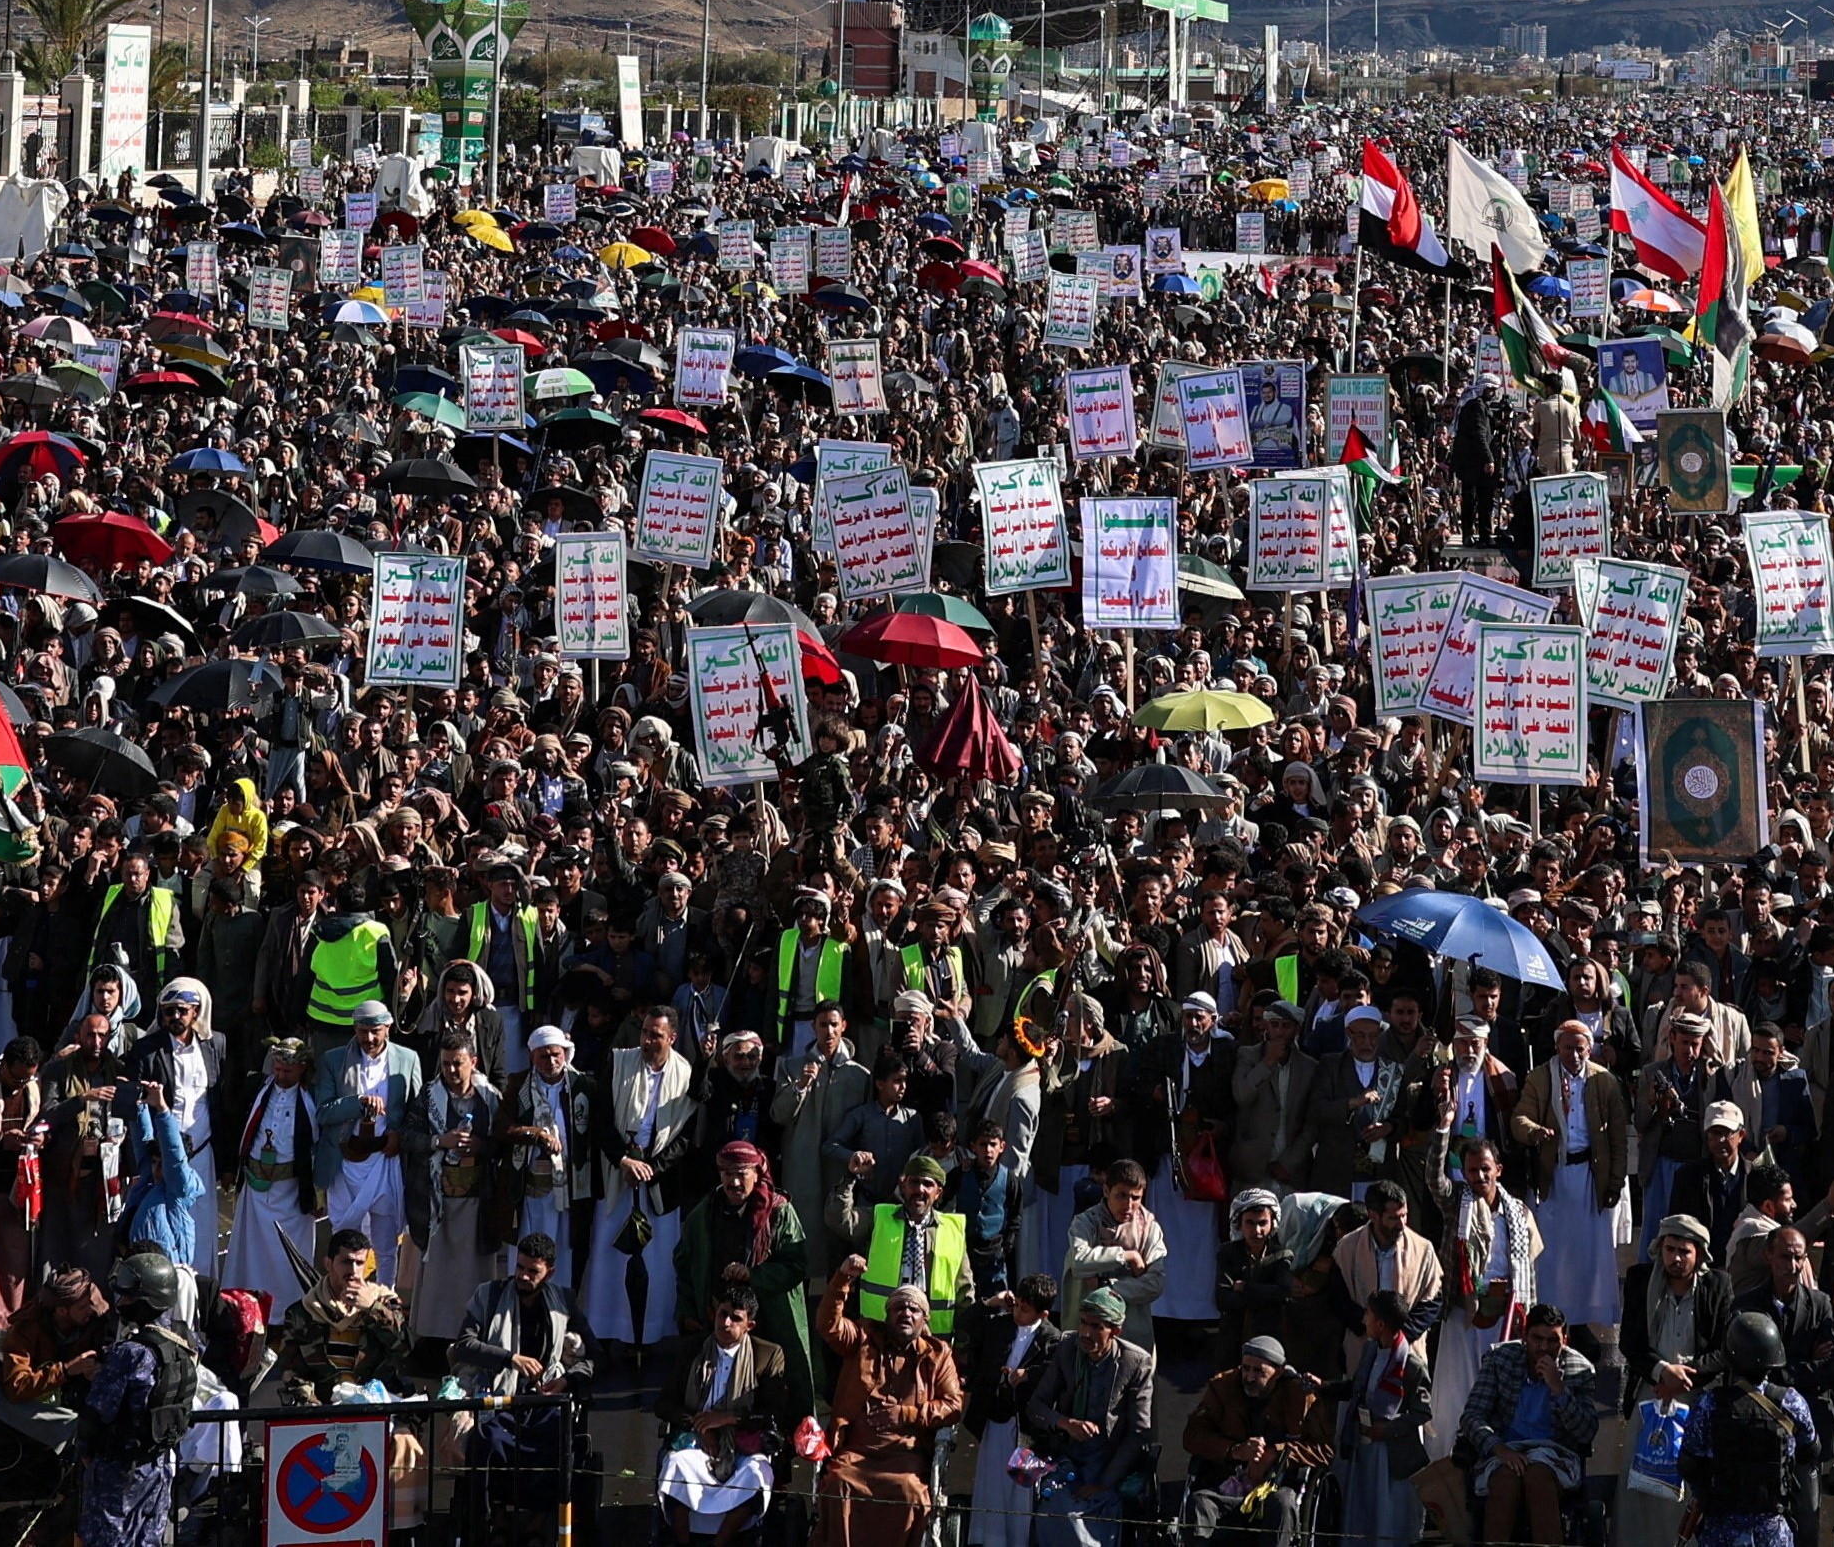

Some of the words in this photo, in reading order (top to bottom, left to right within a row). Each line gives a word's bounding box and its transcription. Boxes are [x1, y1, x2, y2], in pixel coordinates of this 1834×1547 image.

[1488, 634, 1540, 665] أكبر
[1543, 639, 1576, 661] الله
[1485, 667, 1533, 687] لأمريكا
[1536, 673, 1575, 689] الموت
[1485, 693, 1534, 713] لإسرائيل
[1535, 698, 1575, 713] الموت
[1484, 718, 1518, 735] اليهود
[1521, 721, 1542, 736] على
[1545, 721, 1575, 734] اللعنة
[1484, 739, 1531, 763] للإسلام
[1534, 740, 1575, 764] النصر
